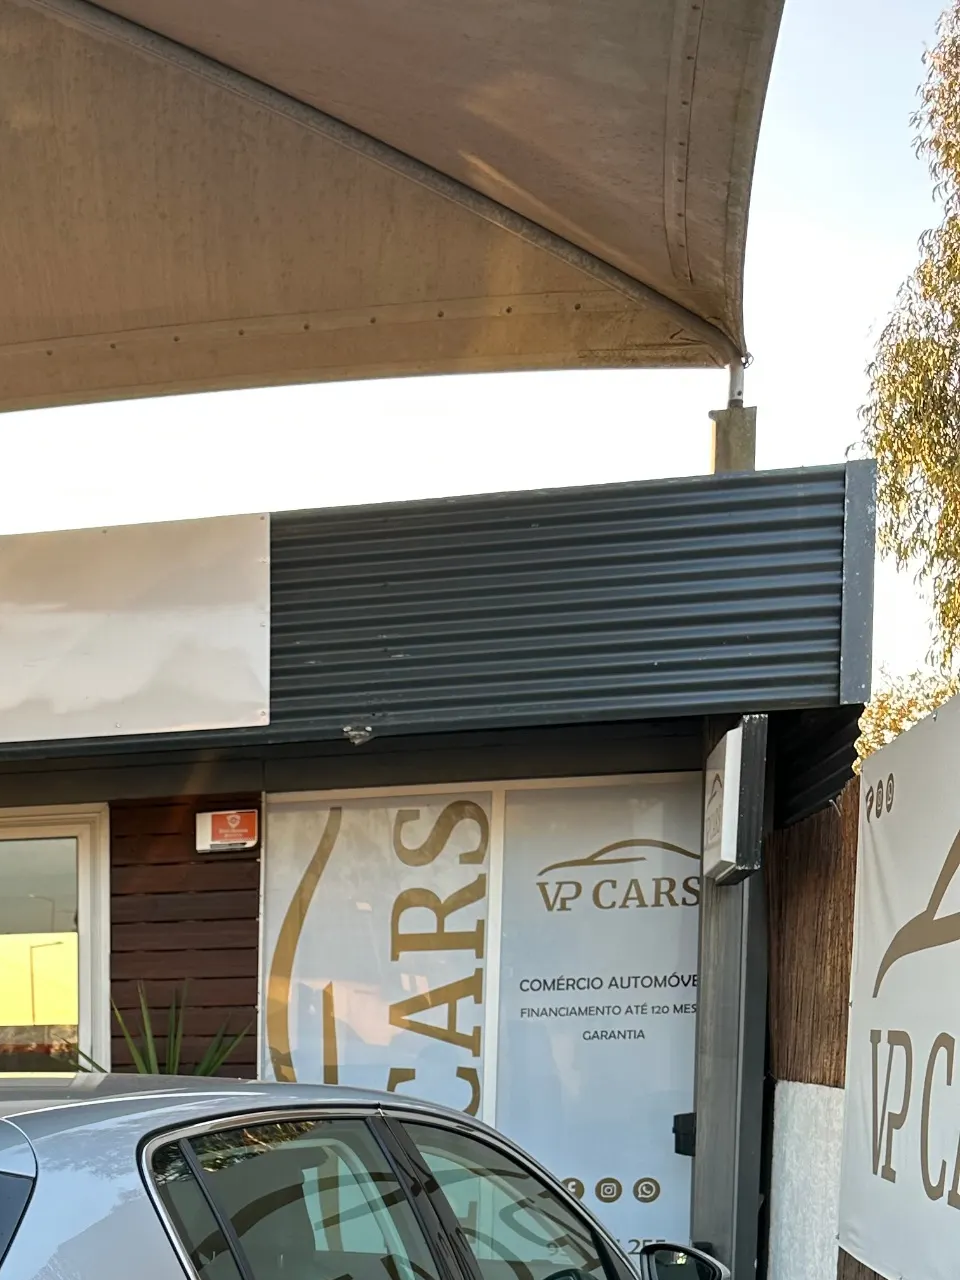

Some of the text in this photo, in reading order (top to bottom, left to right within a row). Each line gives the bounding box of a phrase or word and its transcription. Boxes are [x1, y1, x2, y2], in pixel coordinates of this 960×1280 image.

[536, 876, 700, 911] VP CARS
[519, 975, 604, 992] COMÉRCIO
[520, 1005, 622, 1018] FINANCIAMENTO
[624, 1002, 648, 1015] ATÉ
[651, 1005, 670, 1015] 120
[582, 1029, 646, 1041] GARANTIA
[870, 1029, 913, 1184] VP
